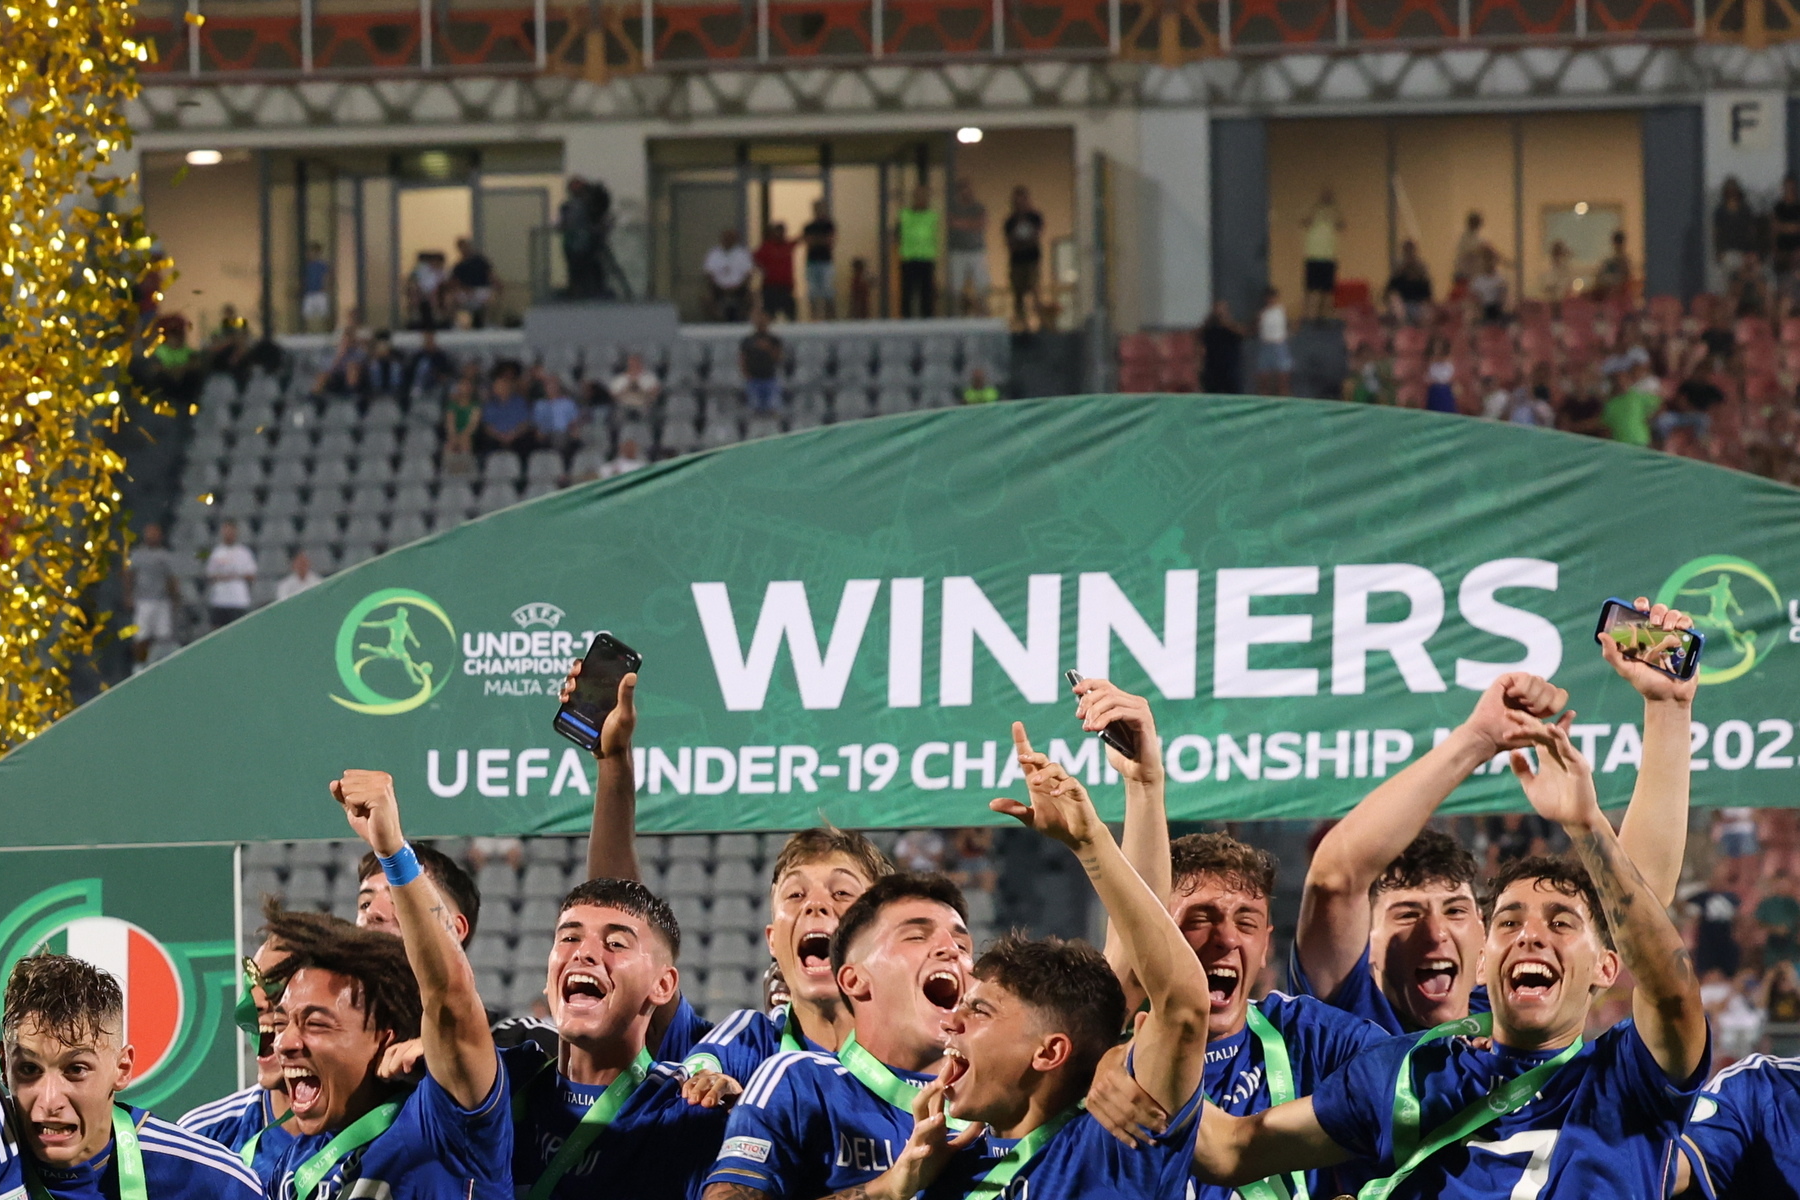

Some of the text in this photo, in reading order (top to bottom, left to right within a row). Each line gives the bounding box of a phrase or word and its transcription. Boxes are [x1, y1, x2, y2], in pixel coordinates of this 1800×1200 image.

[1731, 102, 1759, 143] F
[511, 602, 566, 629] UEFA
[463, 630, 612, 658] UNDER-1
[691, 556, 1563, 711] WINNERS
[484, 678, 542, 696] MALTA
[427, 747, 591, 798] UEFA
[633, 742, 900, 794] UNDER-19
[910, 730, 1416, 790] CHAMONSHIP
[1690, 718, 1800, 771] 202
[563, 1090, 596, 1106] ITALIA
